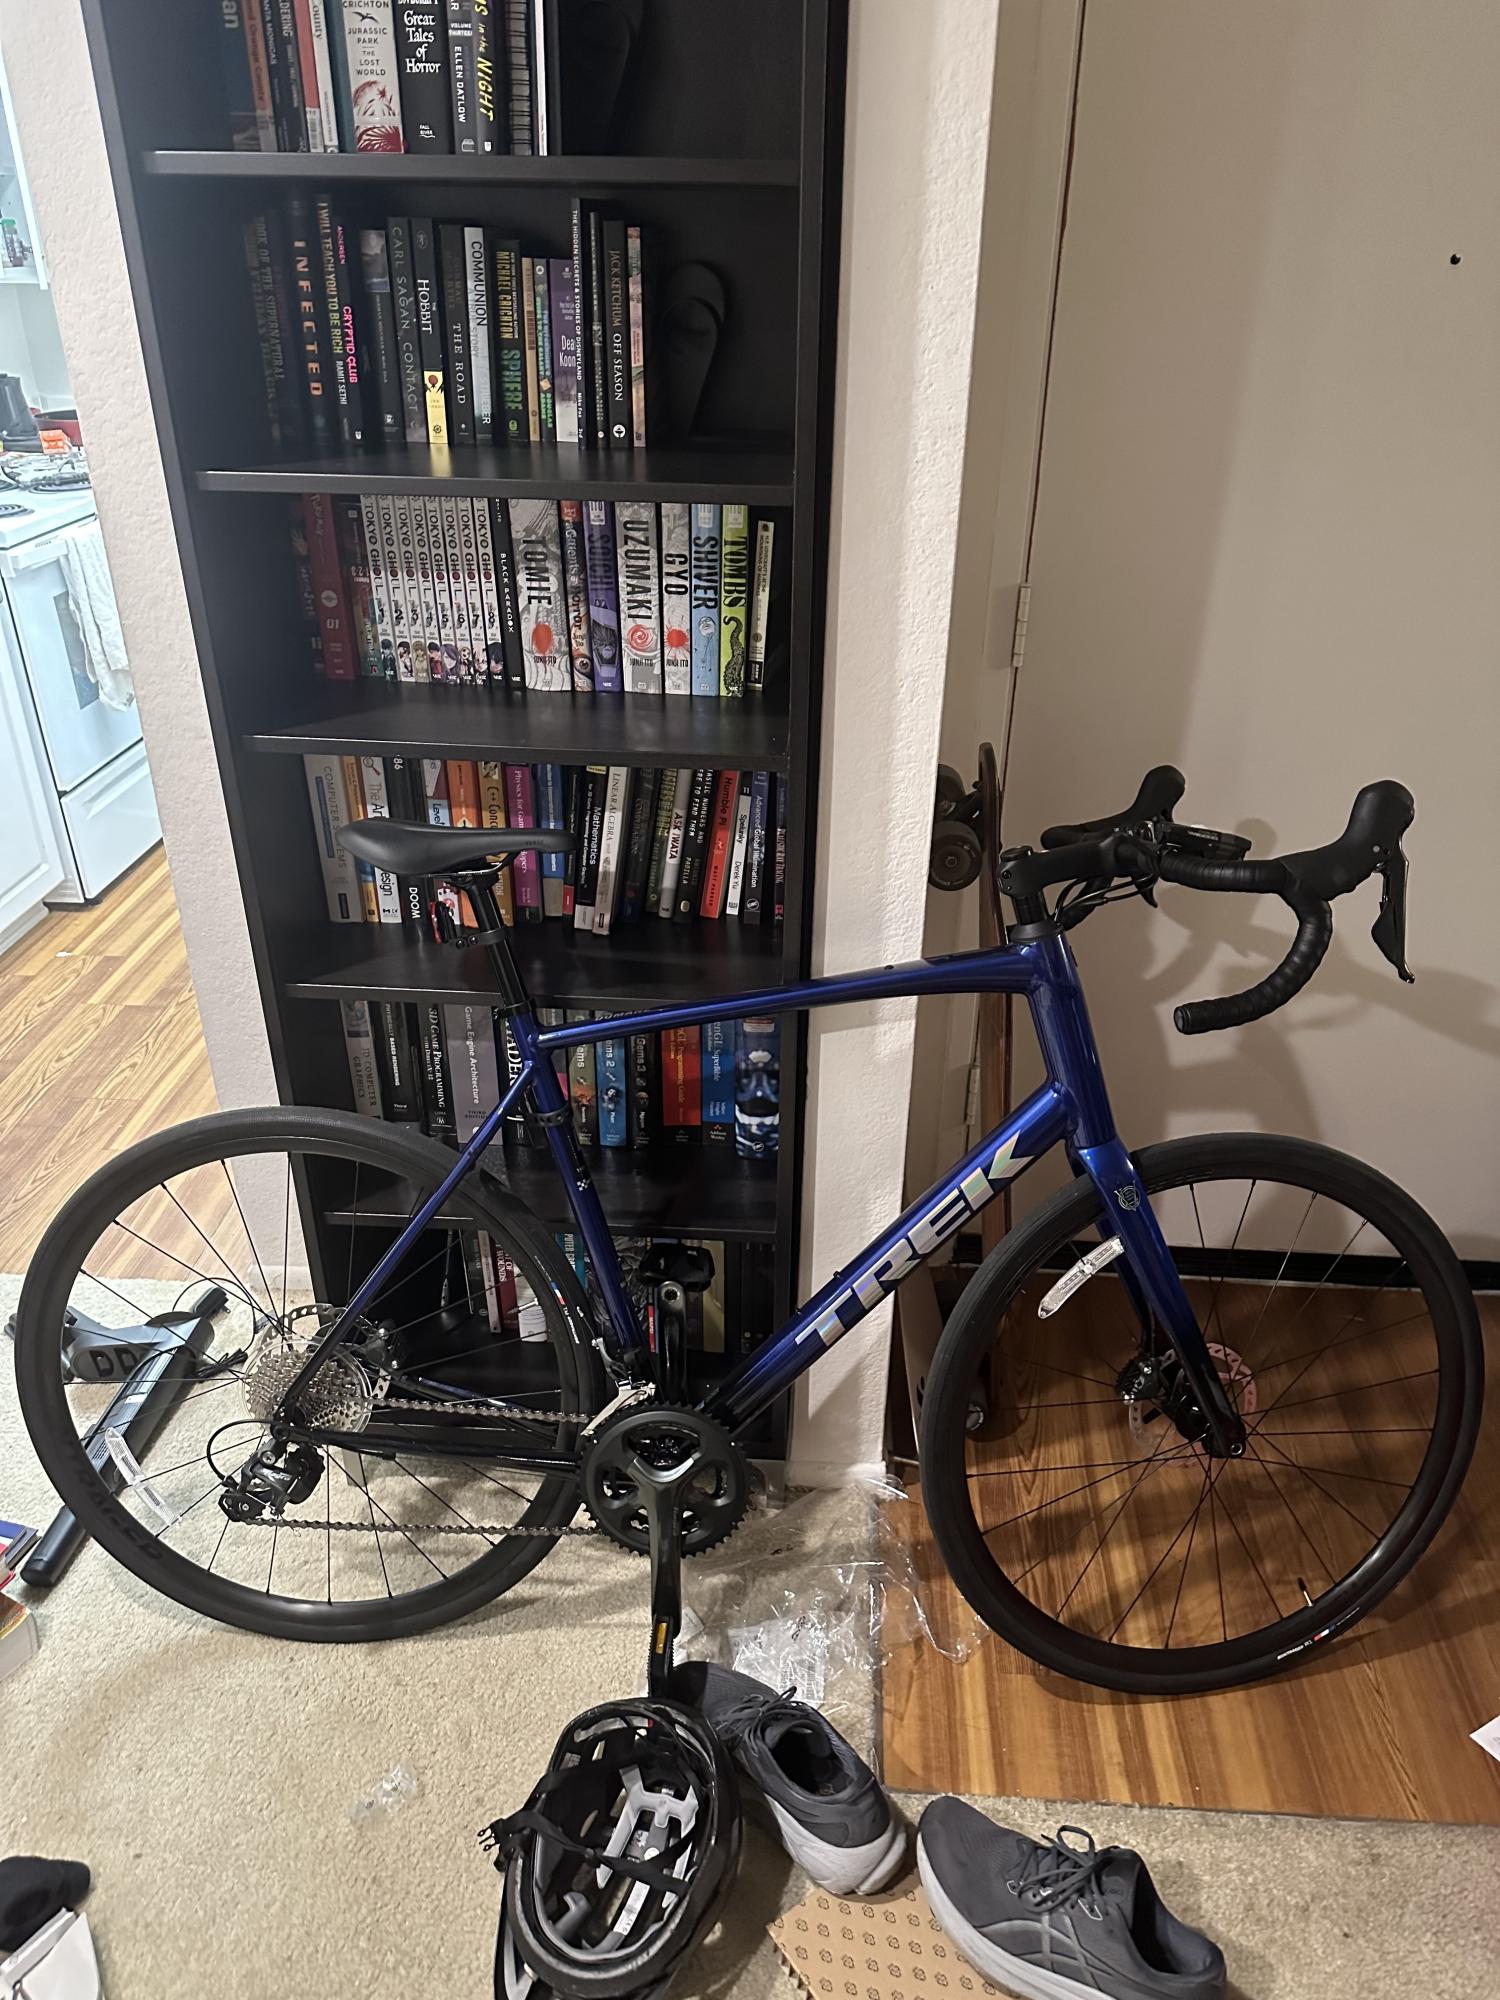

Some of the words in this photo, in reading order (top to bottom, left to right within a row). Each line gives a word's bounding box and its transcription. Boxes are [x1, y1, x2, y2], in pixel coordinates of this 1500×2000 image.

[348, 27, 388, 35] JURASSIC
[404, 11, 436, 27] Great
[406, 28, 435, 43] Tales
[357, 37, 379, 45] PARK
[416, 44, 428, 61] of
[356, 68, 386, 77] WORLD
[359, 58, 380, 67] LOST
[405, 58, 441, 74] Horror
[454, 46, 464, 80] ELLEN
[456, 81, 467, 123] DATLOW
[478, 56, 495, 122] NIGHT
[318, 208, 330, 238] WILL
[321, 237, 335, 273] TEACH
[391, 226, 406, 267] CARL
[609, 250, 619, 276] JACK
[324, 273, 337, 298] YOU
[471, 241, 487, 326] COMMUNION
[496, 251, 511, 292] MICHAEL
[293, 240, 323, 396] INFECTED
[328, 297, 339, 311] TO
[329, 311, 341, 327] BE
[396, 276, 411, 329] SAGAN
[417, 279, 433, 334] HOBBIT
[499, 294, 514, 339] CRICHTON
[611, 278, 623, 327] KETCHUM
[332, 327, 344, 354] RICH
[342, 306, 356, 354] CRYPTID
[453, 323, 463, 354] THE
[575, 326, 581, 335] OF
[612, 333, 622, 355] OFF
[346, 356, 358, 383] CLUB
[403, 341, 418, 412] CONTACT
[455, 362, 466, 404] ROAD
[502, 349, 523, 411] SPHERE
[613, 358, 623, 401] SEASON
[364, 505, 378, 546] TOKYO
[381, 505, 395, 548] TOKYO
[397, 505, 411, 548] TOKYO
[414, 506, 426, 549] TOKYO
[428, 507, 442, 550] TOKYO
[444, 507, 457, 550] TOKYO
[460, 507, 473, 550] TOKYO
[477, 507, 489, 551] TOKYO
[370, 549, 384, 594] GHOUL
[387, 550, 401, 597] GHOUL
[403, 551, 417, 595] GHOUL
[418, 551, 432, 596] GHOUL
[434, 552, 447, 597] GHOUL
[450, 553, 463, 597] GHOUL
[465, 553, 477, 598] GHOUL
[481, 553, 493, 598] GHOUL
[500, 553, 509, 584] BLACK
[522, 535, 552, 606] TOMIE
[587, 533, 614, 591] SOICHI
[623, 520, 653, 619] UZUMAKI
[664, 553, 689, 596] GYO
[692, 535, 719, 610] SHIVER
[722, 535, 748, 608] TOMBS
[504, 587, 514, 633] PARADOX
[368, 783, 382, 801] The
[487, 786, 500, 803] C++
[514, 770, 523, 795] Physics
[610, 773, 621, 803] LINEAR
[694, 786, 702, 795] TO
[720, 778, 732, 814] Humble
[324, 765, 340, 822] COMPUTER
[332, 824, 347, 868] SEMS
[371, 802, 385, 817] Ar
[606, 804, 618, 841] ALGEBRA
[672, 811, 683, 831] ASK
[689, 819, 697, 836] THEM
[699, 798, 709, 828] NUMBERS
[754, 795, 763, 829] Advanced
[589, 806, 601, 865] Mathematics
[668, 832, 681, 860] IWATA
[697, 831, 705, 844] AND
[736, 814, 747, 845] Spelunky
[753, 829, 761, 851] Global
[380, 871, 395, 896] esign
[733, 861, 742, 880] Derek
[751, 851, 759, 888] Illumination
[408, 887, 421, 919] DOOM
[428, 1008, 439, 1023] 3D
[465, 1006, 473, 1029] Game
[467, 1031, 475, 1057] Engine
[469, 1057, 480, 1105] Architecture
[637, 1064, 646, 1072] 3
[795, 1129, 1035, 1346] TREK
[496, 1250, 506, 1283] WOUNDS
